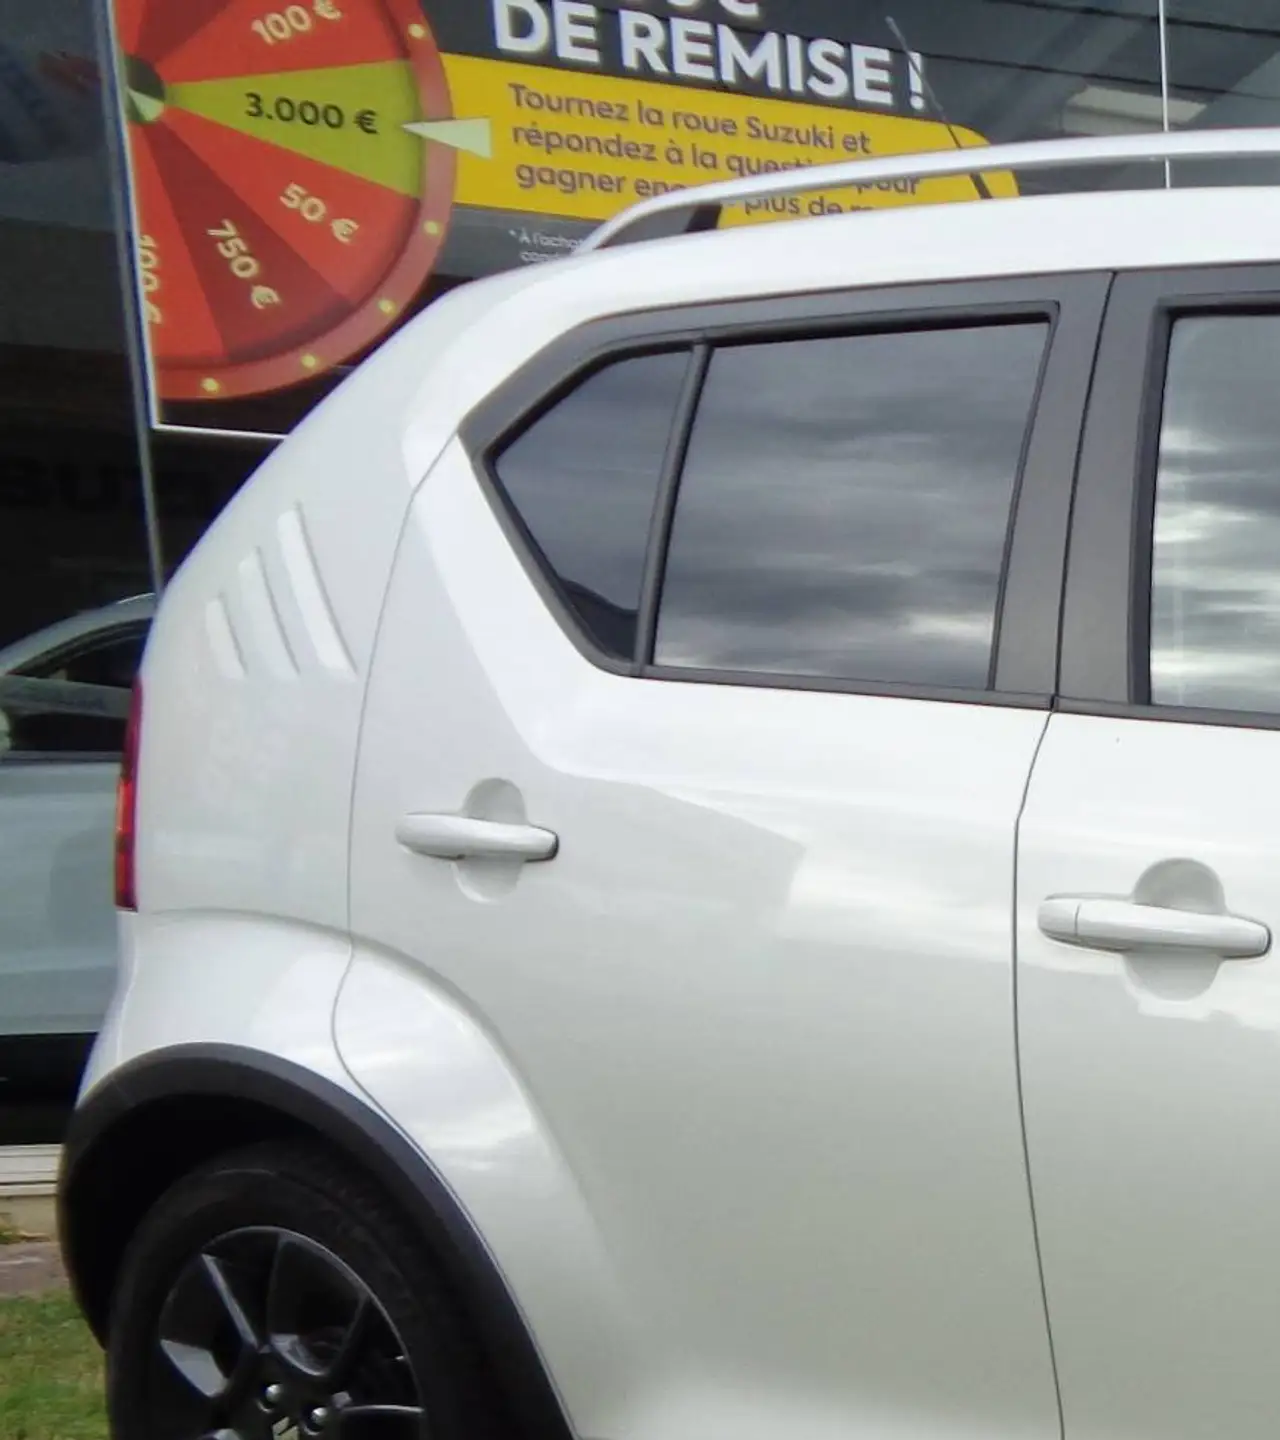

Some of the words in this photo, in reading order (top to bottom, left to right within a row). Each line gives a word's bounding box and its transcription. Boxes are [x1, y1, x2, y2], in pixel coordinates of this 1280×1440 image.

[251, 4, 312, 46] 100
[494, 0, 600, 64] DE
[618, 9, 893, 106] REMISE
[907, 51, 926, 110] !
[244, 91, 345, 130] 3.000
[353, 109, 379, 135] €
[507, 82, 630, 123] Tournez
[636, 99, 665, 127] la
[671, 109, 738, 136] roue
[746, 115, 836, 150] Suzuki
[841, 131, 872, 154] et
[511, 121, 659, 163] répondez
[664, 138, 685, 166] à
[691, 143, 718, 170] la
[515, 163, 627, 195] gagner
[279, 182, 327, 222] 50
[330, 217, 360, 243] €
[206, 219, 259, 279] 750
[251, 284, 281, 311] €
